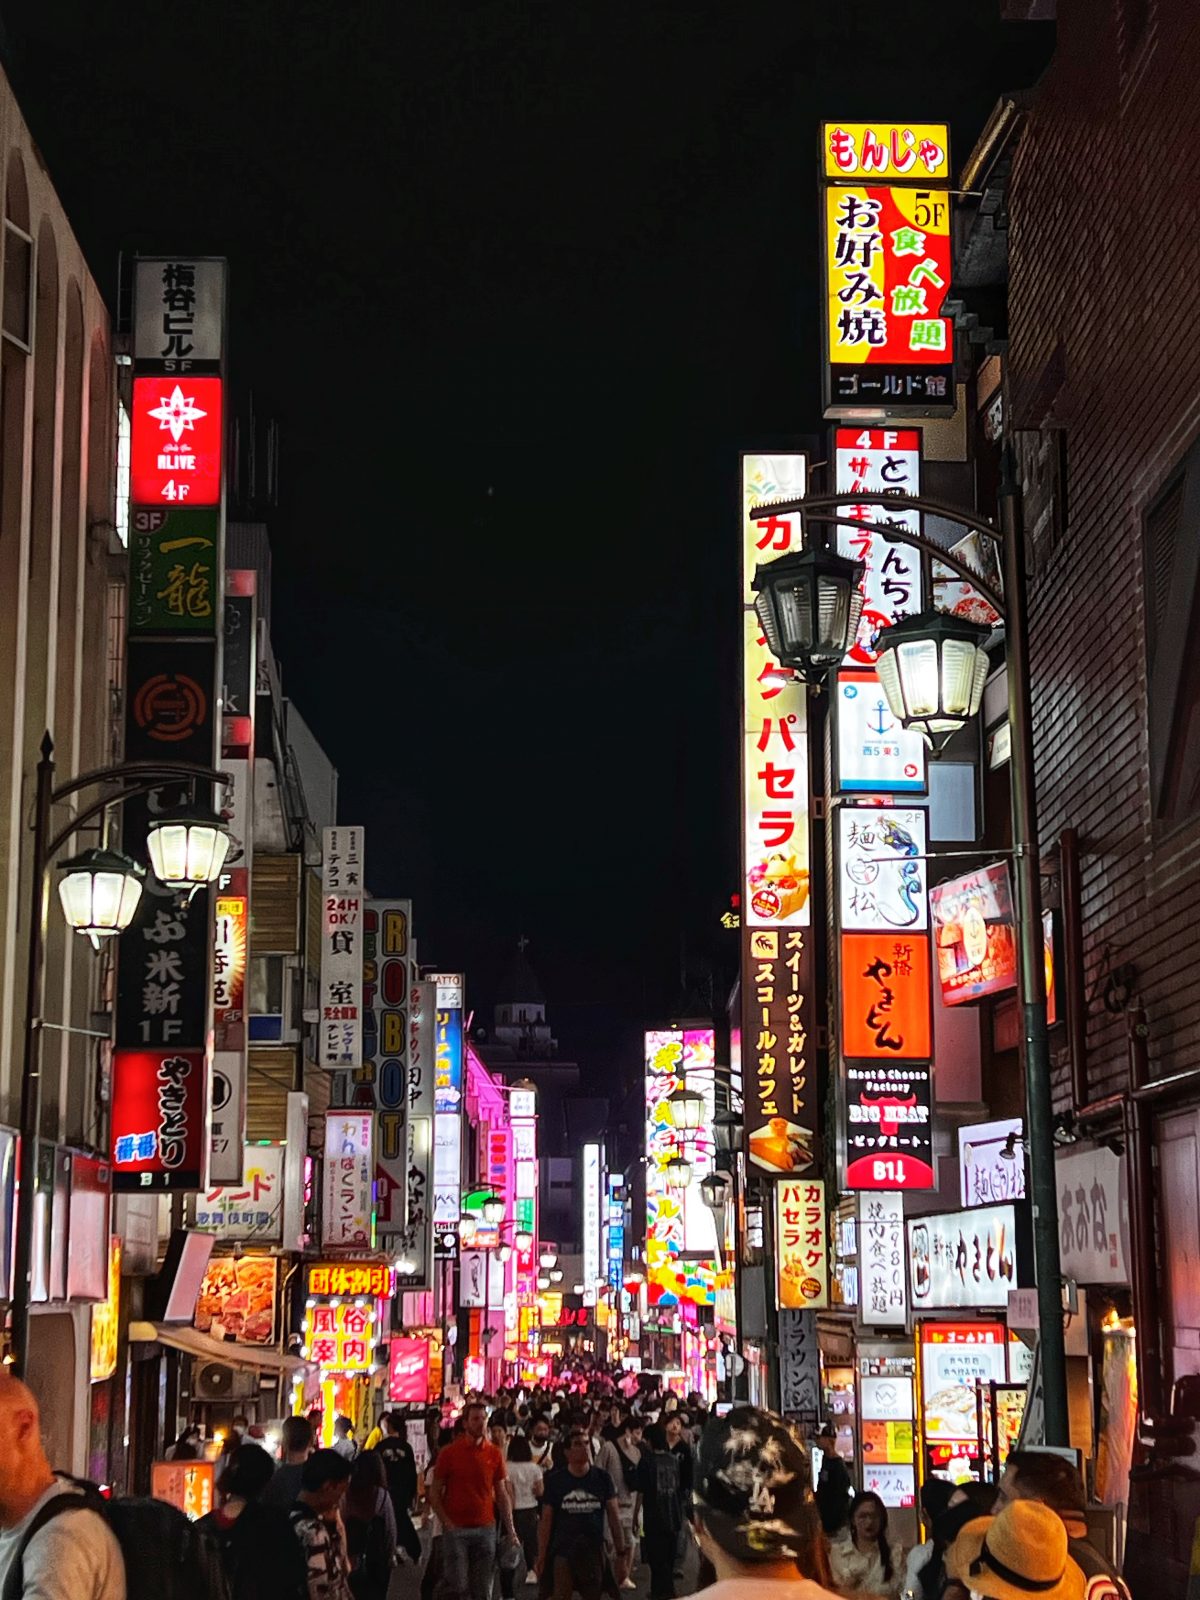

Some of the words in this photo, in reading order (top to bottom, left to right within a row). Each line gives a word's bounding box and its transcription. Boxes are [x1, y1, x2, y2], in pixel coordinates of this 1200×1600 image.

[829, 127, 944, 172] もんじゃ
[914, 192, 945, 227] 5F
[834, 196, 885, 346] お好み焼
[890, 226, 947, 351] 食べ放題
[164, 360, 192, 371] 5F
[838, 374, 947, 397] ゴールド館
[856, 430, 898, 449] 4F
[161, 480, 190, 500] 4F
[135, 512, 161, 530] 3F
[157, 536, 214, 619] 一龍
[905, 813, 922, 824] 2F
[327, 898, 359, 911] 24H
[329, 912, 358, 925] OK!
[863, 955, 904, 1051] やきとん
[138, 1018, 183, 1042] 1F
[785, 931, 807, 1115] スイーツ&ガレット
[754, 963, 778, 1115] スコールカフェ
[848, 1068, 876, 1079] Meat
[865, 1081, 910, 1093] Factory
[157, 1056, 192, 1169] やきとり
[848, 1104, 881, 1123] BIG
[883, 1105, 929, 1123] MEAT
[140, 1173, 171, 1186] B1
[873, 1159, 895, 1180] B1
[782, 1185, 800, 1247] パセラ
[804, 1185, 823, 1267] カラオケ
[889, 1212, 903, 1306] 2980円
[308, 1266, 390, 1296] 団体割引
[312, 1306, 368, 1334] 風俗
[310, 1339, 367, 1364] 案内
